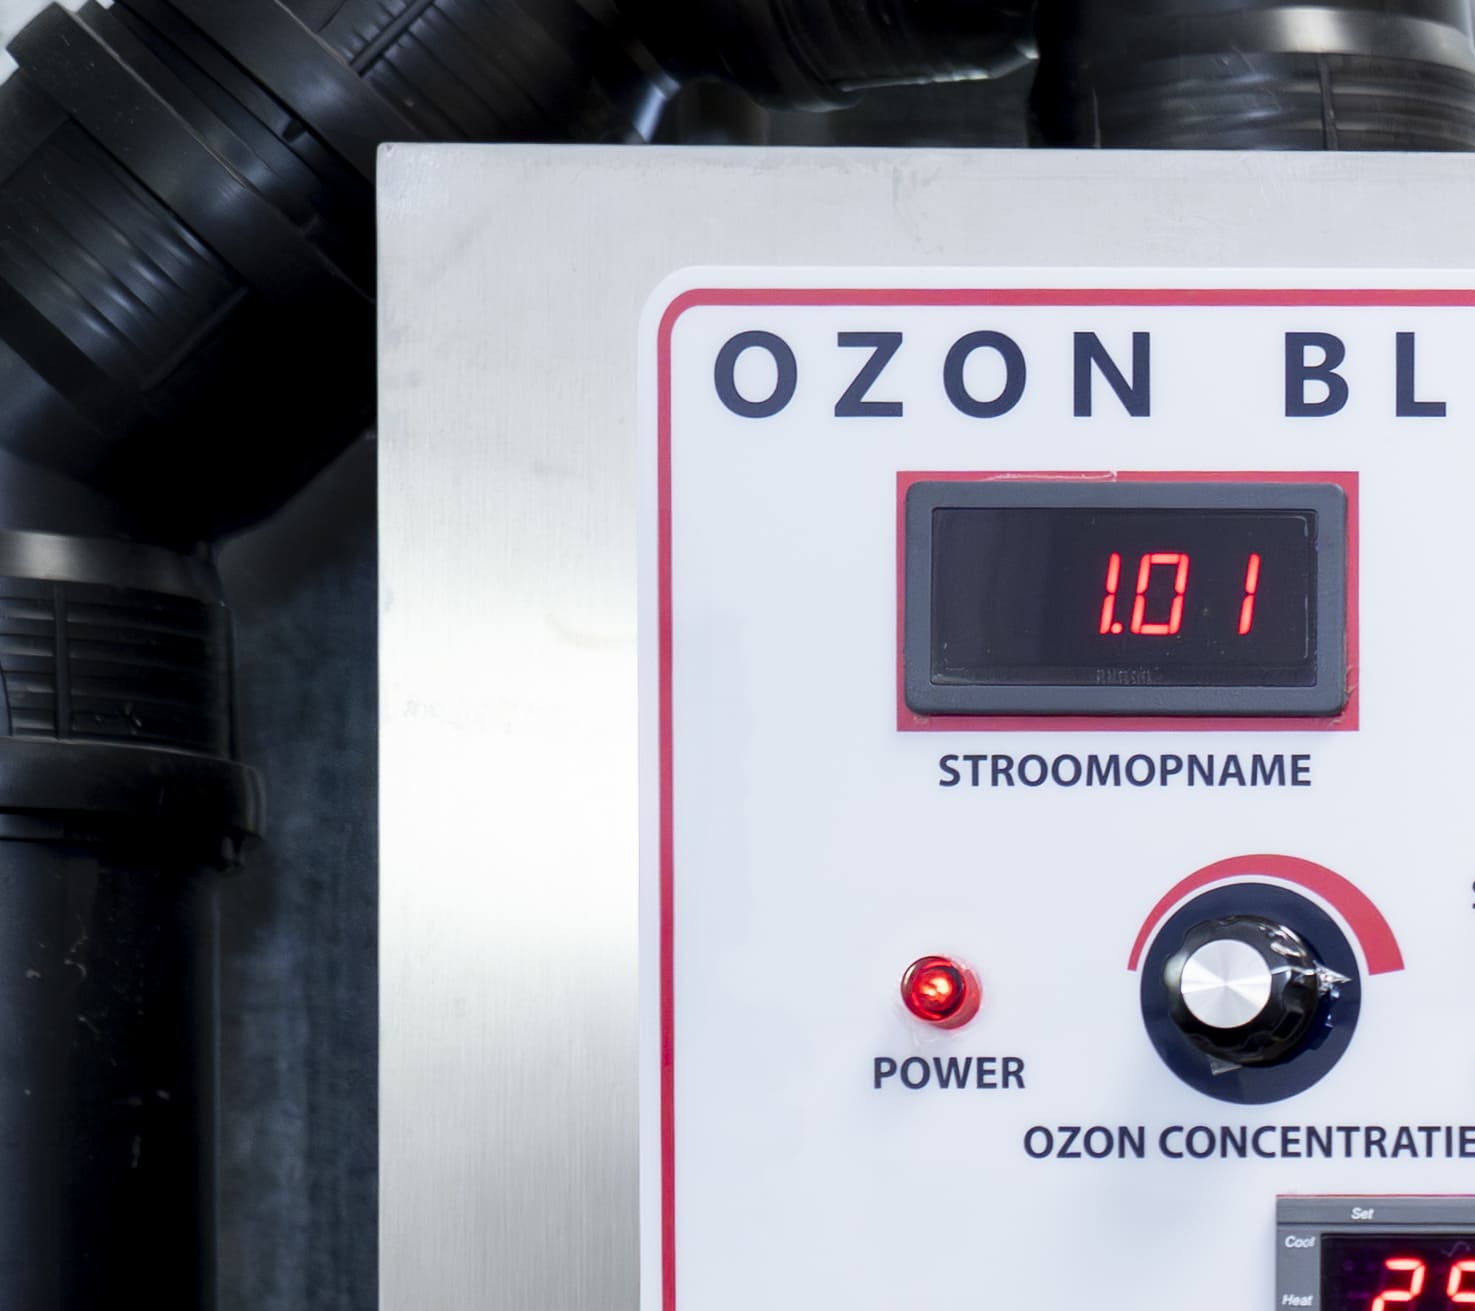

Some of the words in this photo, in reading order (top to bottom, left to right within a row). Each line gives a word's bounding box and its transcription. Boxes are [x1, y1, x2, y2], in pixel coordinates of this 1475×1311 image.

[713, 329, 1151, 419] OZON
[938, 753, 1312, 788] STROOMOPNAME
[873, 1055, 1026, 1090] POWER
[1023, 1125, 1146, 1159] OZON
[1351, 1207, 1375, 1220] Set
[1284, 1235, 1316, 1249] Cool
[1281, 1294, 1314, 1307] Heat
